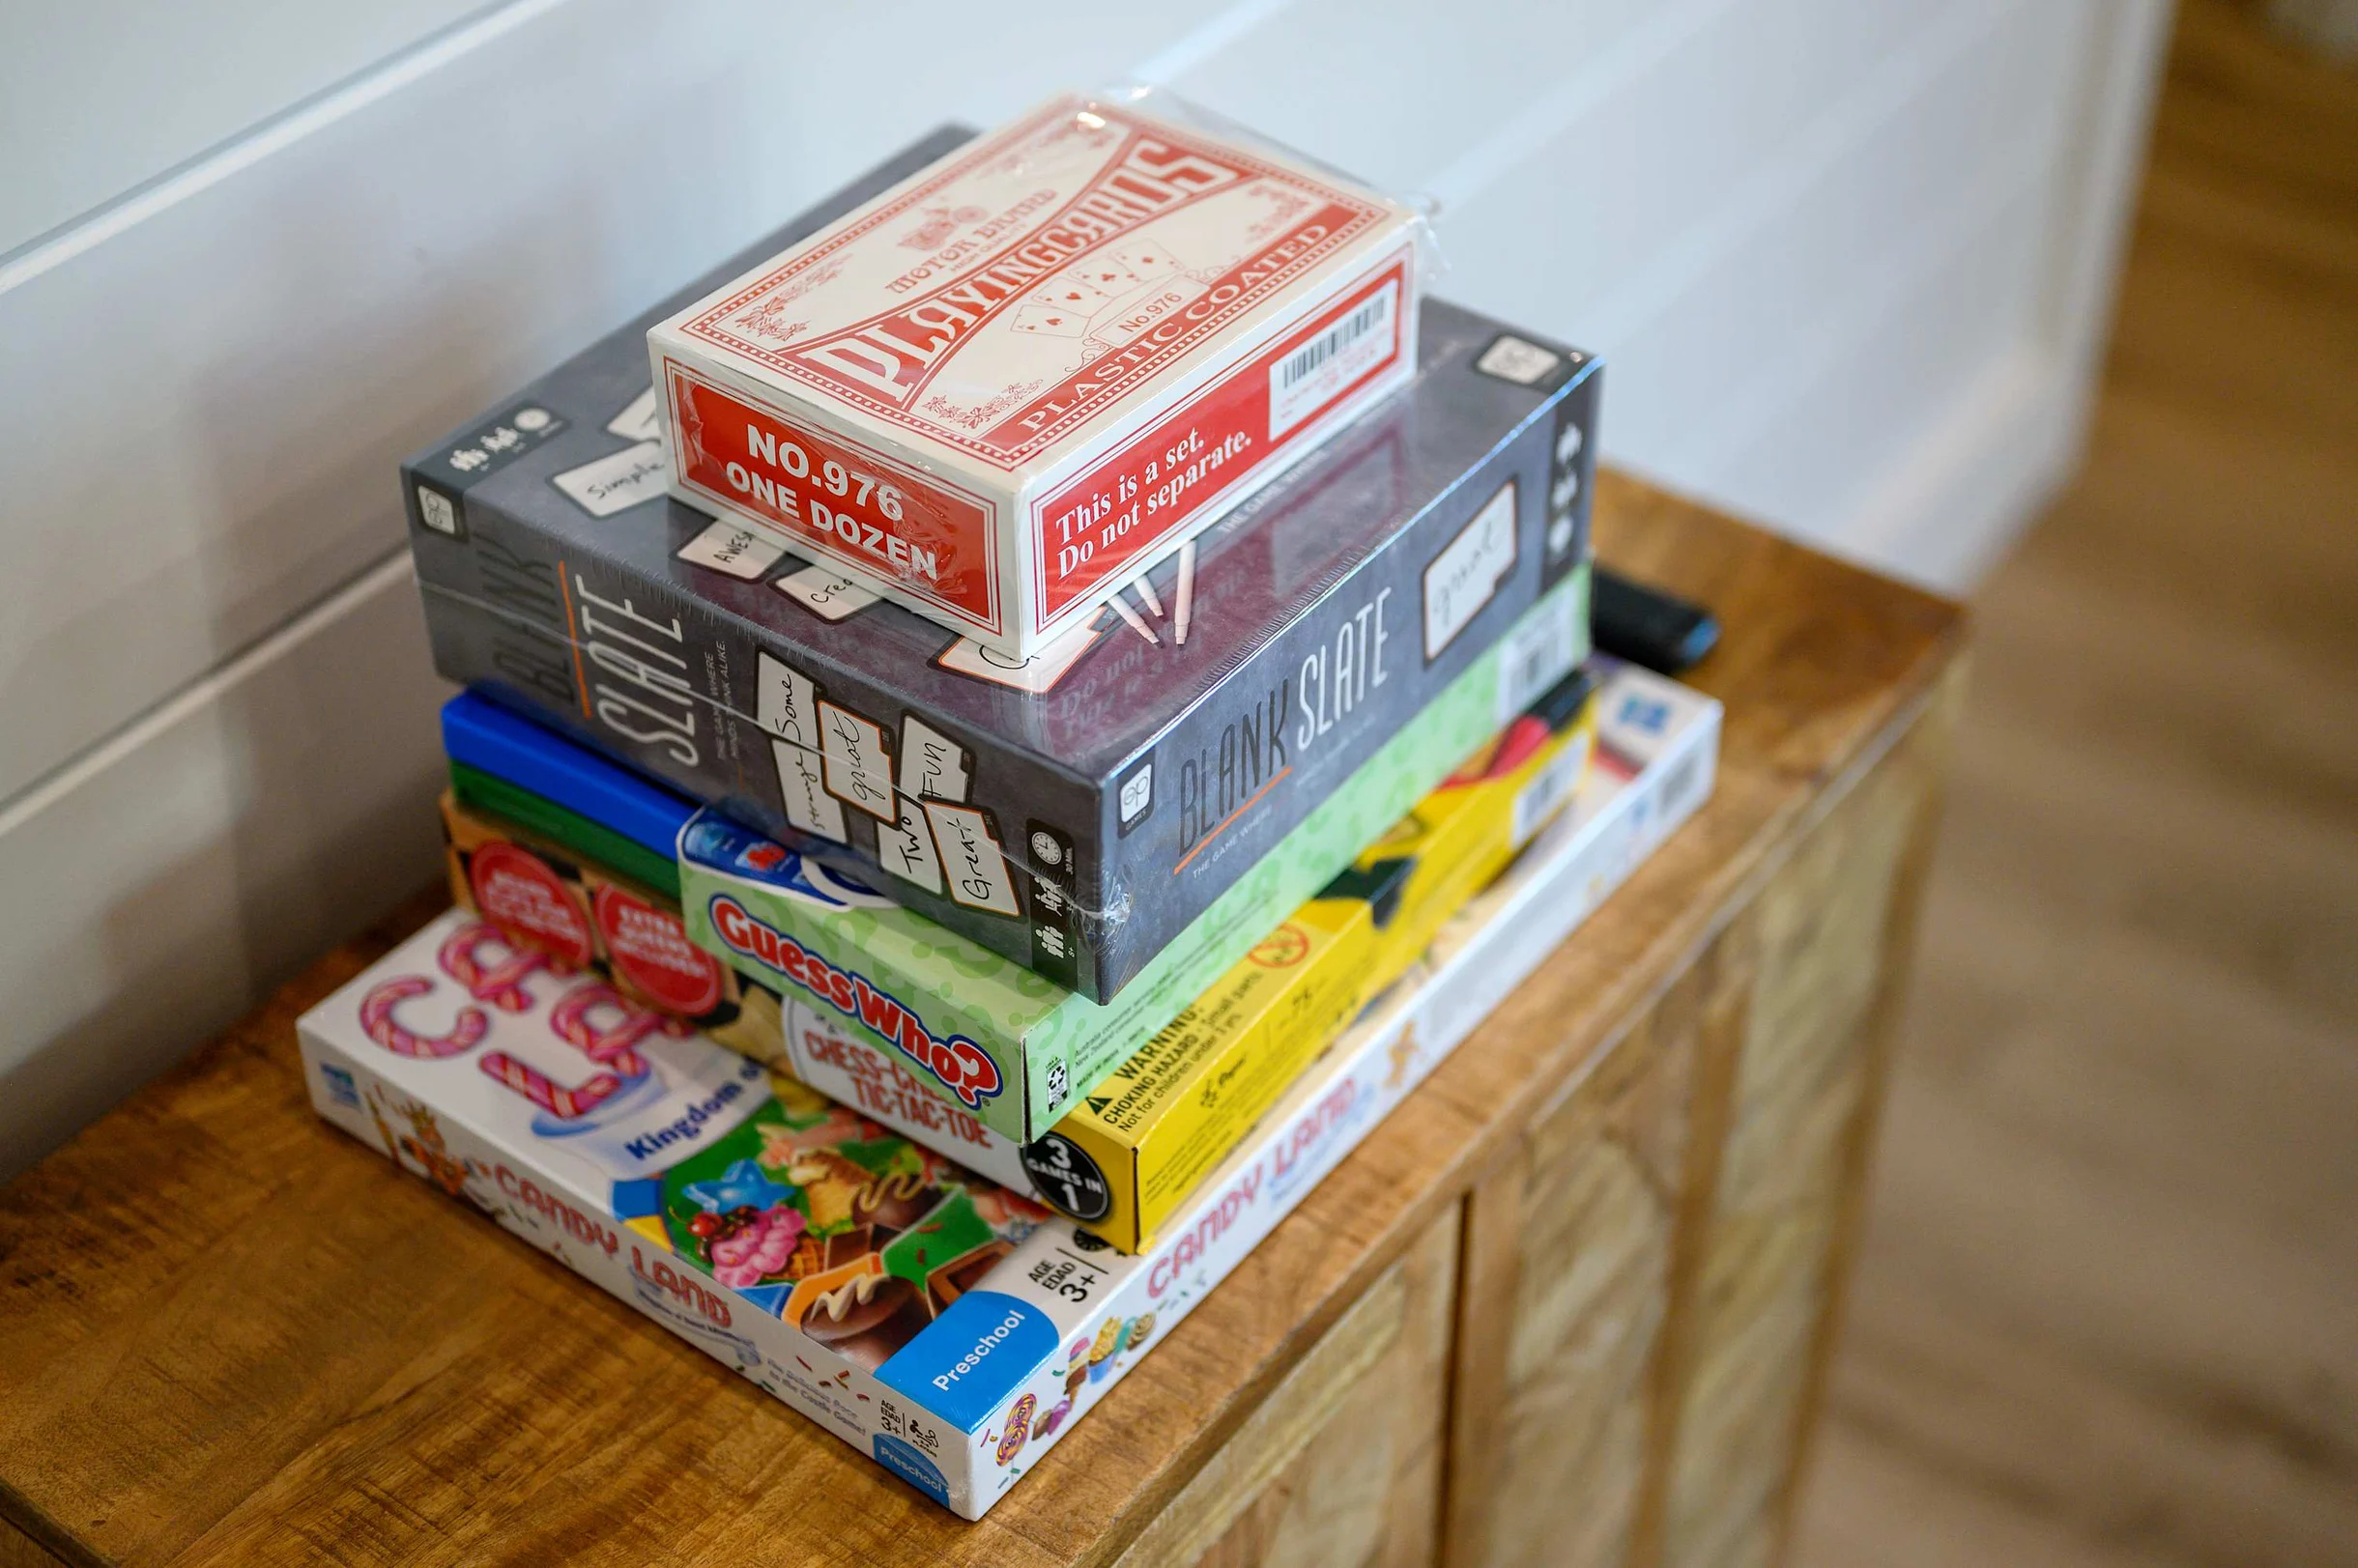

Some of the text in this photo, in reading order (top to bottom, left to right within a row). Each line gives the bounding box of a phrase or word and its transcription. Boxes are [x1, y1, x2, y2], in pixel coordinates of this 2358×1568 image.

[885, 240, 979, 294] MOTOR
[1017, 323, 1184, 433] PLASTIC
[1185, 224, 1330, 320] COATED
[1118, 292, 1184, 333] No.976
[586, 463, 665, 500] Simple
[747, 423, 905, 522] NO.976
[1055, 427, 1205, 546] This is a set.
[726, 461, 938, 581] ONE DOZEN
[1057, 431, 1252, 580] Do not separate.
[713, 531, 756, 564] AWES
[575, 574, 700, 767] SLATE
[775, 674, 801, 742] Some
[1178, 678, 1289, 858] BLANK
[1297, 586, 1393, 752] SLATE
[947, 817, 992, 900] Great
[1193, 857, 1211, 879] THE
[1212, 834, 1238, 863] GAME
[1104, 1075, 1157, 1125] CHOKING
[1154, 1033, 1199, 1078] HAZARD
[1118, 1114, 1142, 1132] Not
[1140, 1098, 1156, 1113] for
[1154, 1061, 1193, 1098] children
[1193, 1034, 1218, 1062] under
[624, 1081, 742, 1160] Kingdom
[850, 1074, 993, 1149] TIC-TAC-TOE
[1027, 1157, 1104, 1194] GAMES IN
[1046, 1138, 1072, 1170] 3
[1062, 1183, 1079, 1212] 1
[1028, 1260, 1056, 1283] AGE
[1042, 1262, 1077, 1291] EDAD
[1059, 1274, 1096, 1302] 3+
[933, 1309, 1025, 1392] Preschool
[880, 1407, 901, 1424] EDAD
[881, 1400, 897, 1413] AGE
[881, 1416, 902, 1436] 3+
[880, 1446, 942, 1493] Preschool
